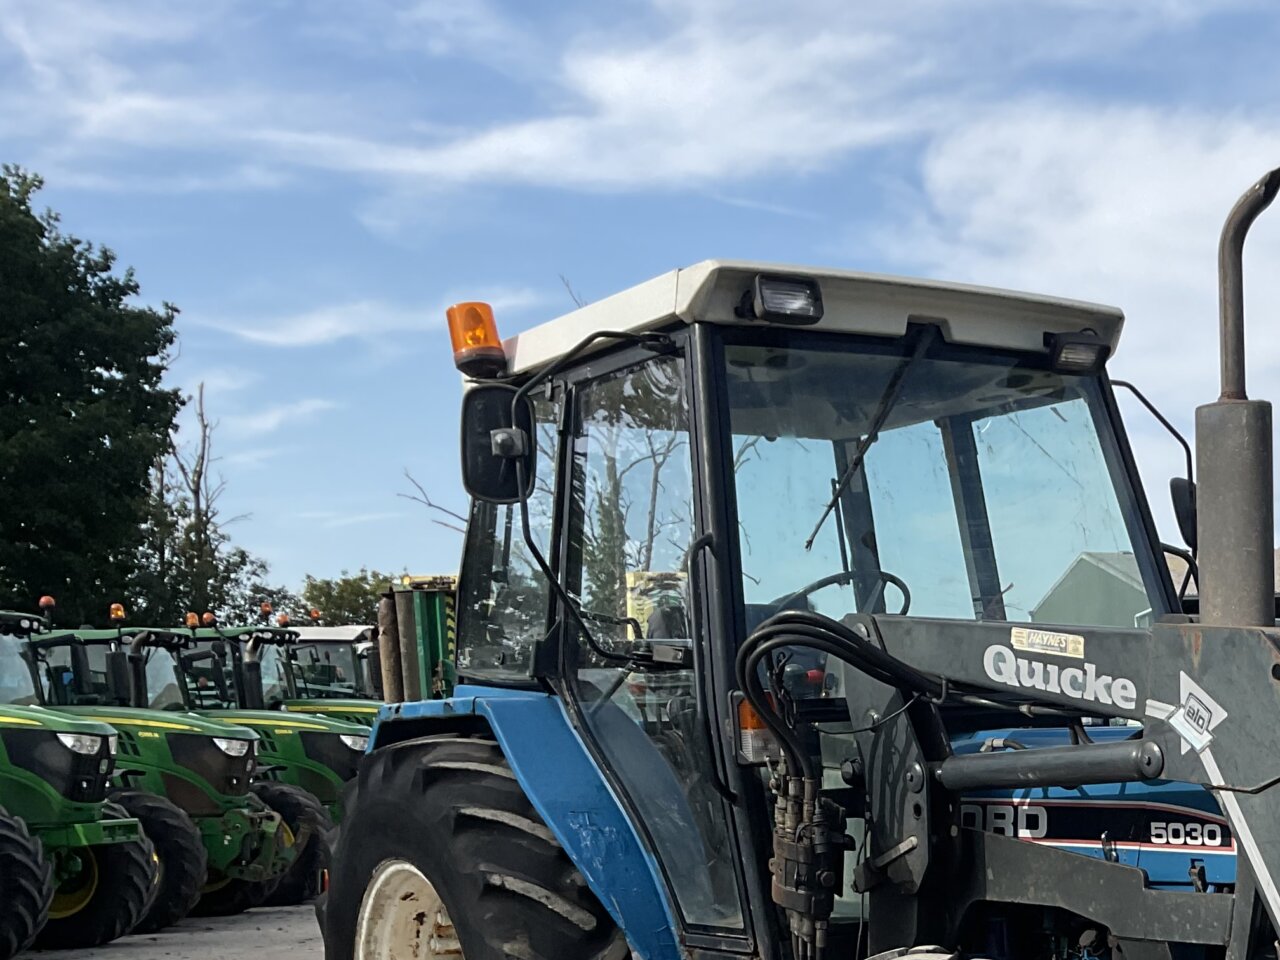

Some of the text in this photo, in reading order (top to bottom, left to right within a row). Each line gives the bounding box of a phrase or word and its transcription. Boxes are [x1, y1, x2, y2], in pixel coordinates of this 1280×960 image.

[1028, 632, 1067, 647] HAYNES
[983, 644, 1137, 710] Quicke
[1150, 822, 1222, 846] 5030
